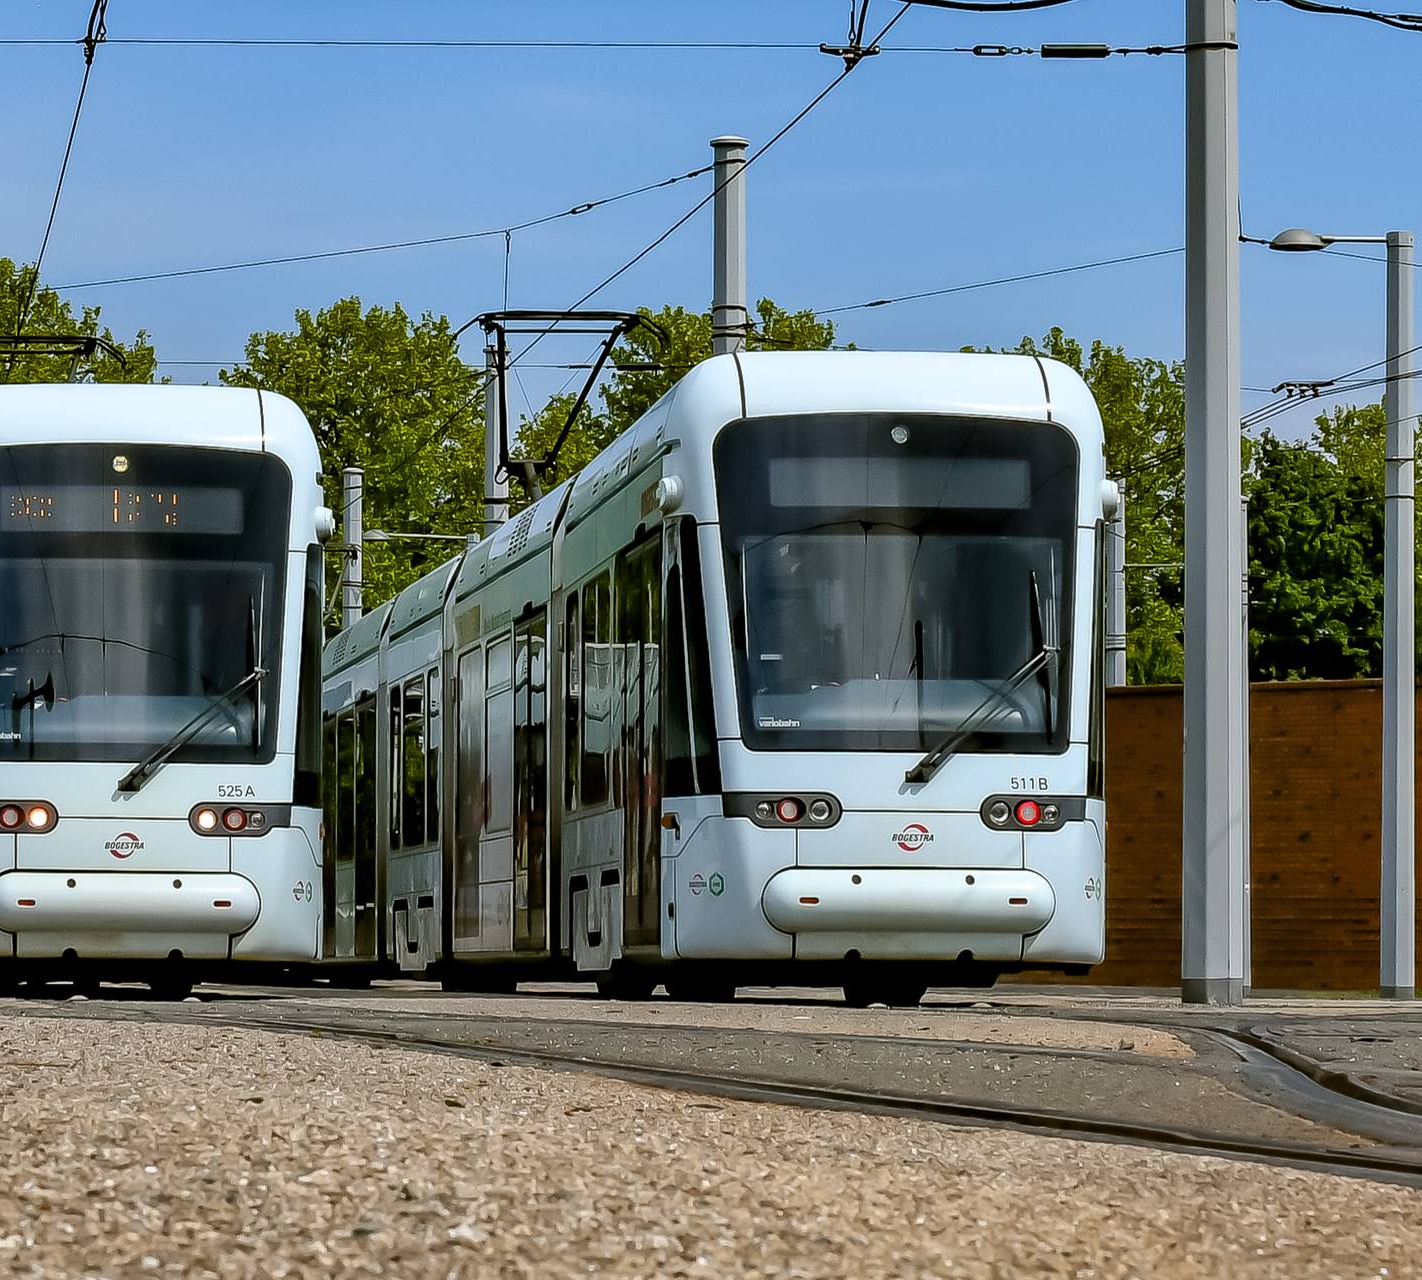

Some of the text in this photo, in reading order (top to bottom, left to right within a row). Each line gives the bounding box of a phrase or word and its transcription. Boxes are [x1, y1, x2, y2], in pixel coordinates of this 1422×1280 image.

[218, 785, 243, 797] 525
[892, 833, 934, 842] BOGESTRA
[105, 841, 144, 850] BOGESTRA
